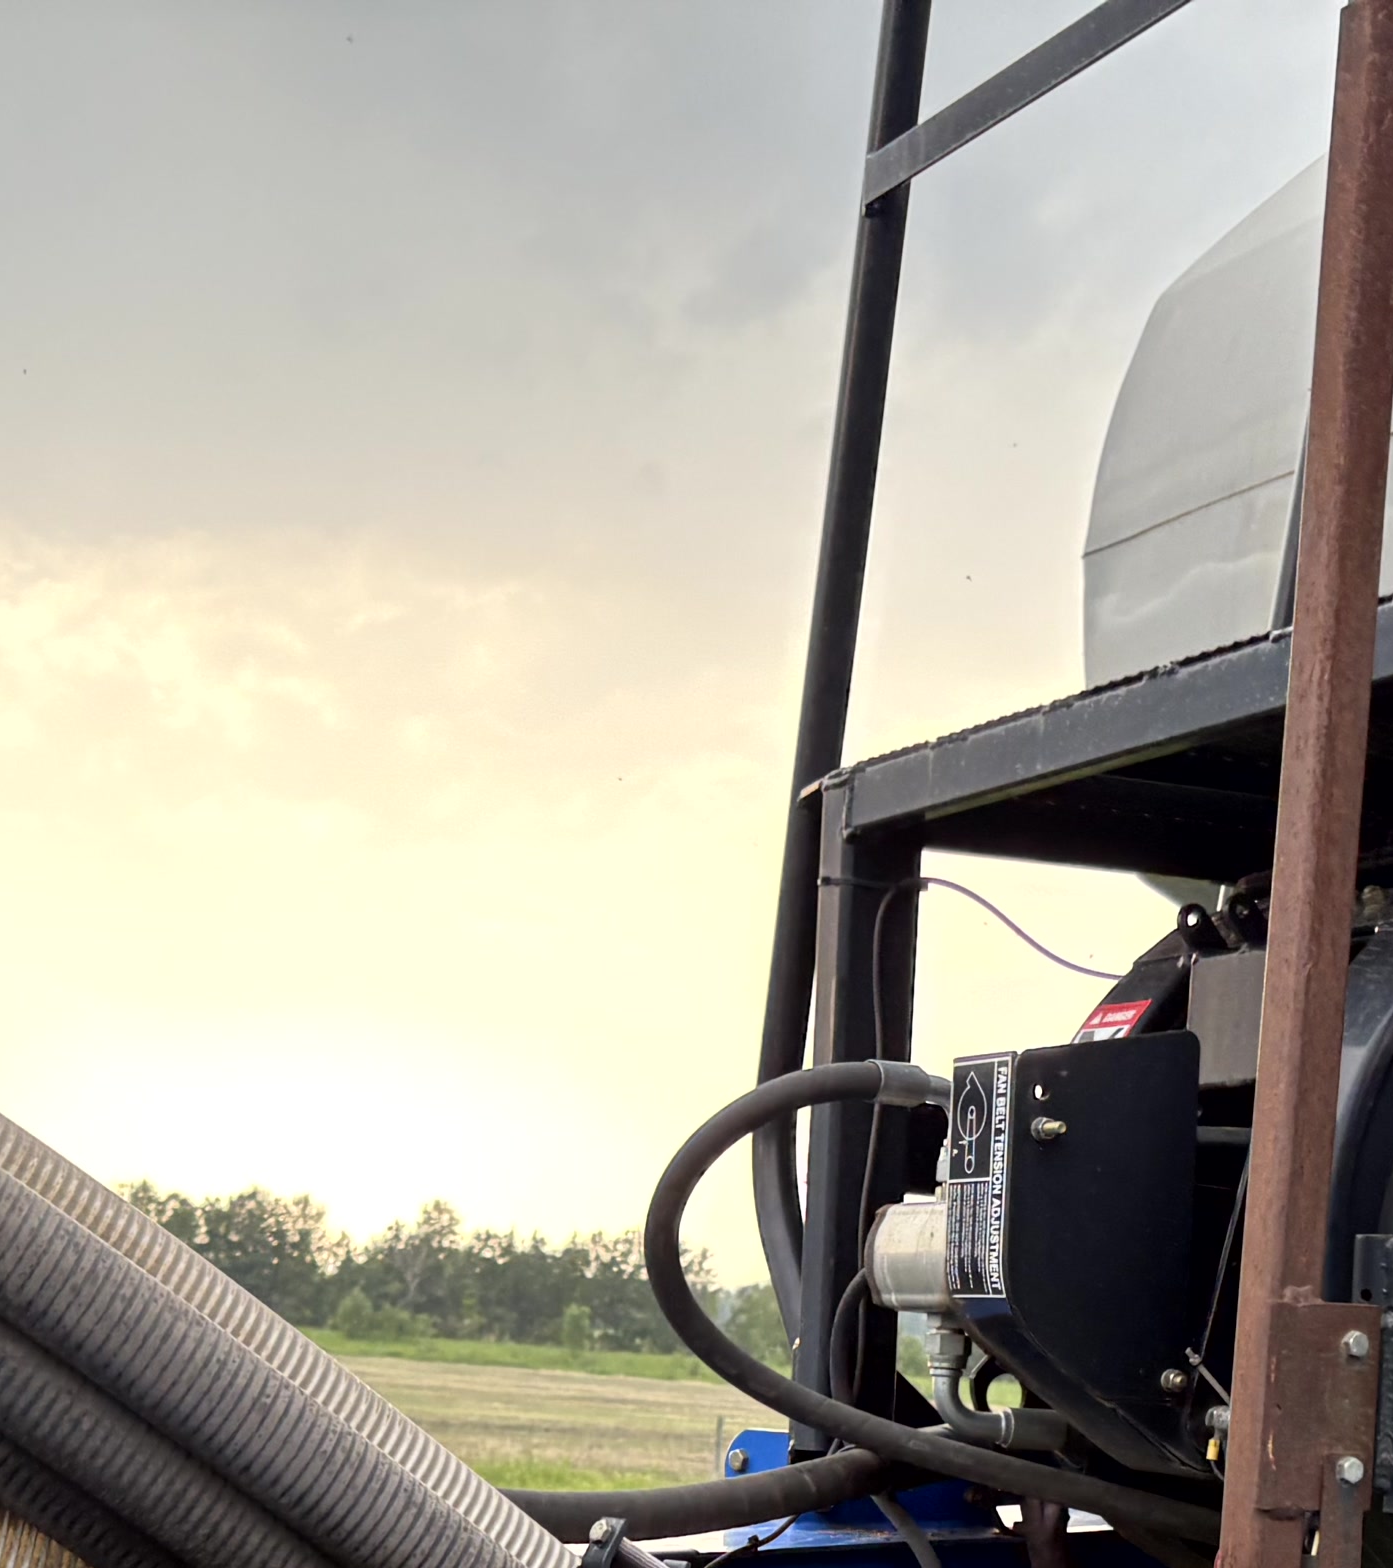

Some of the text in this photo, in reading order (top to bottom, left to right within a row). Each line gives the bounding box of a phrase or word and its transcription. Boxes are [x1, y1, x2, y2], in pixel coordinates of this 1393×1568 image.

[989, 1066, 1008, 1291] FAN BELT TENSION ADJUSTMENT
